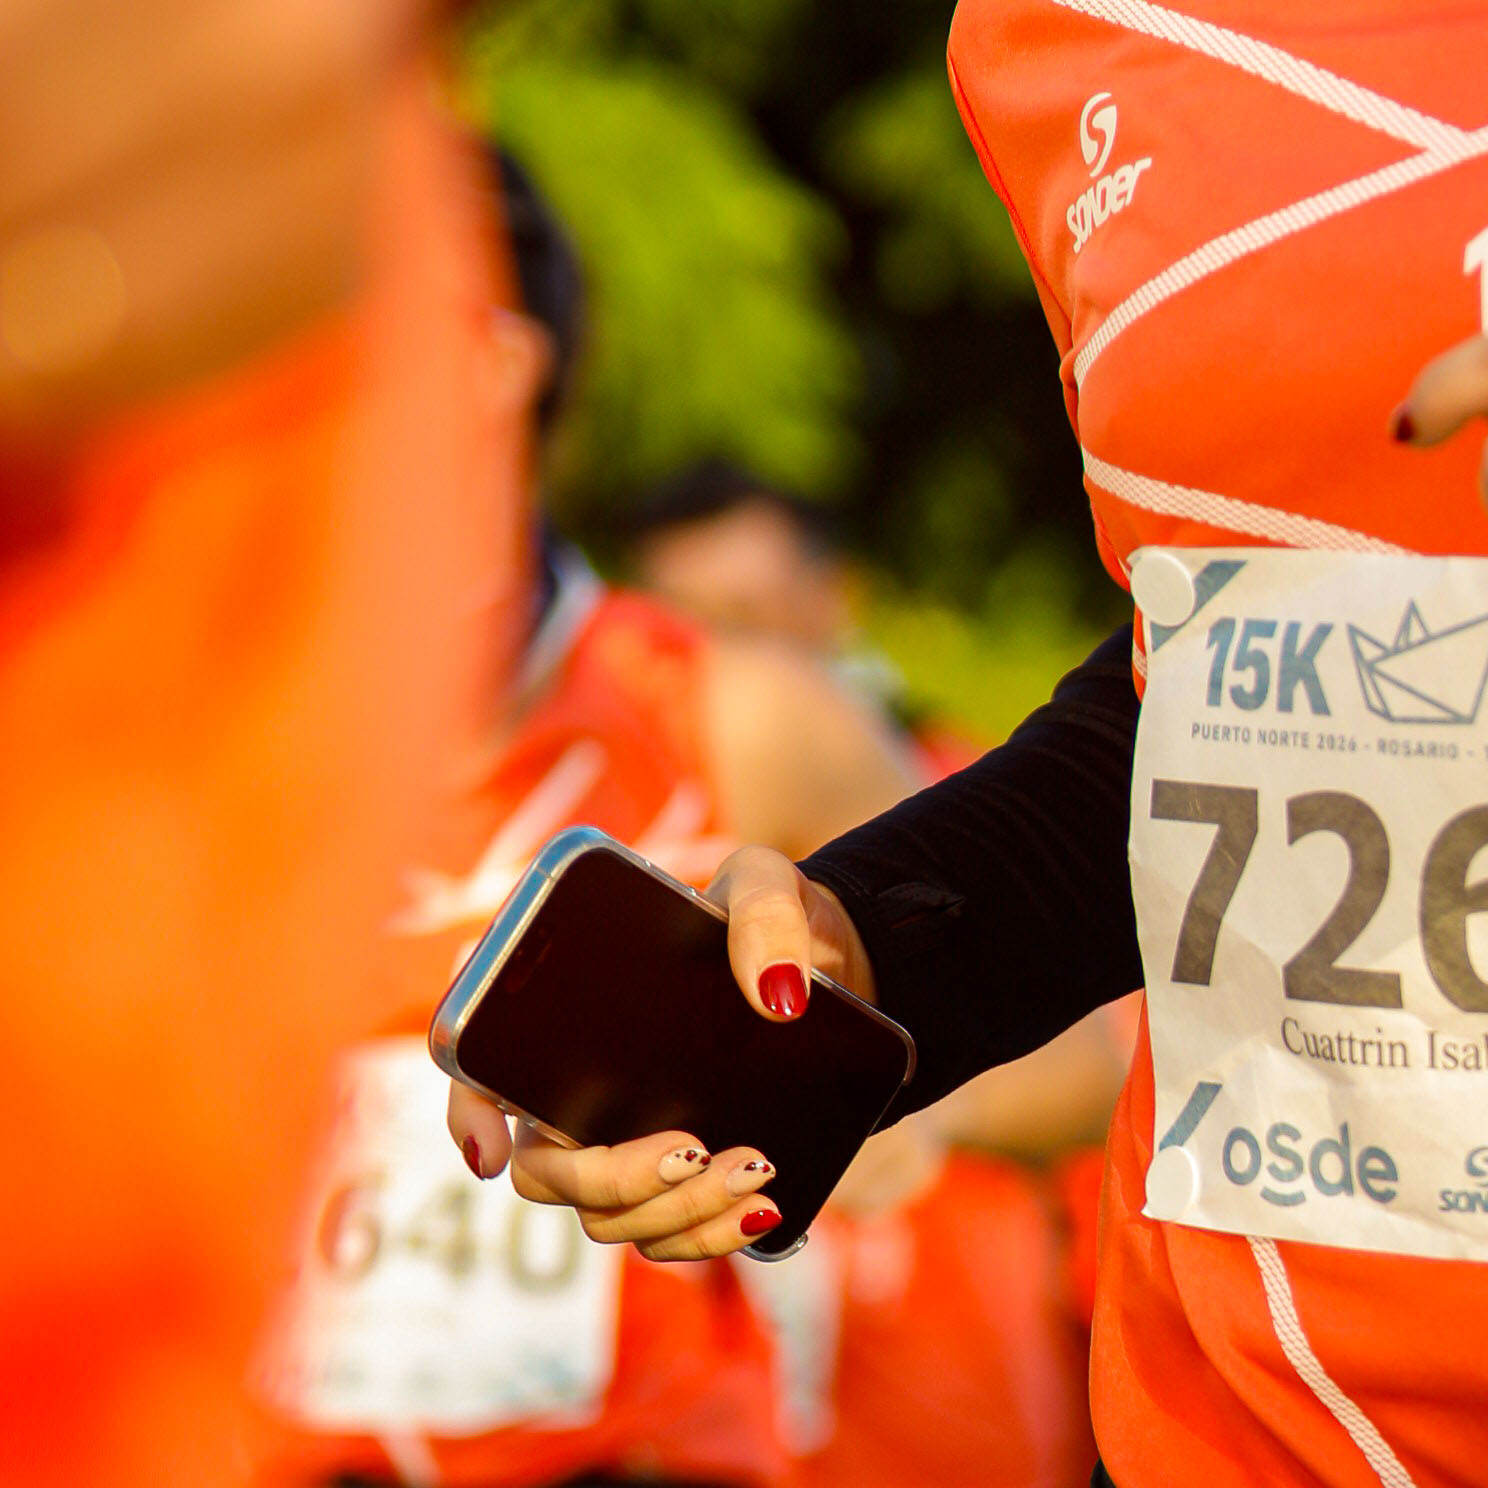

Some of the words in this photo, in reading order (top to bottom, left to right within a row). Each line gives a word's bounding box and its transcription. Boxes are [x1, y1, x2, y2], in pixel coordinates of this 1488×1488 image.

[1206, 617, 1333, 716] 15K
[1191, 722, 1250, 744] PUERTO
[1257, 728, 1310, 750] NORTE
[1376, 737, 1459, 760] ROSARIO
[1281, 1016, 1410, 1068] Cuattrin
[1222, 1121, 1398, 1205] osde
